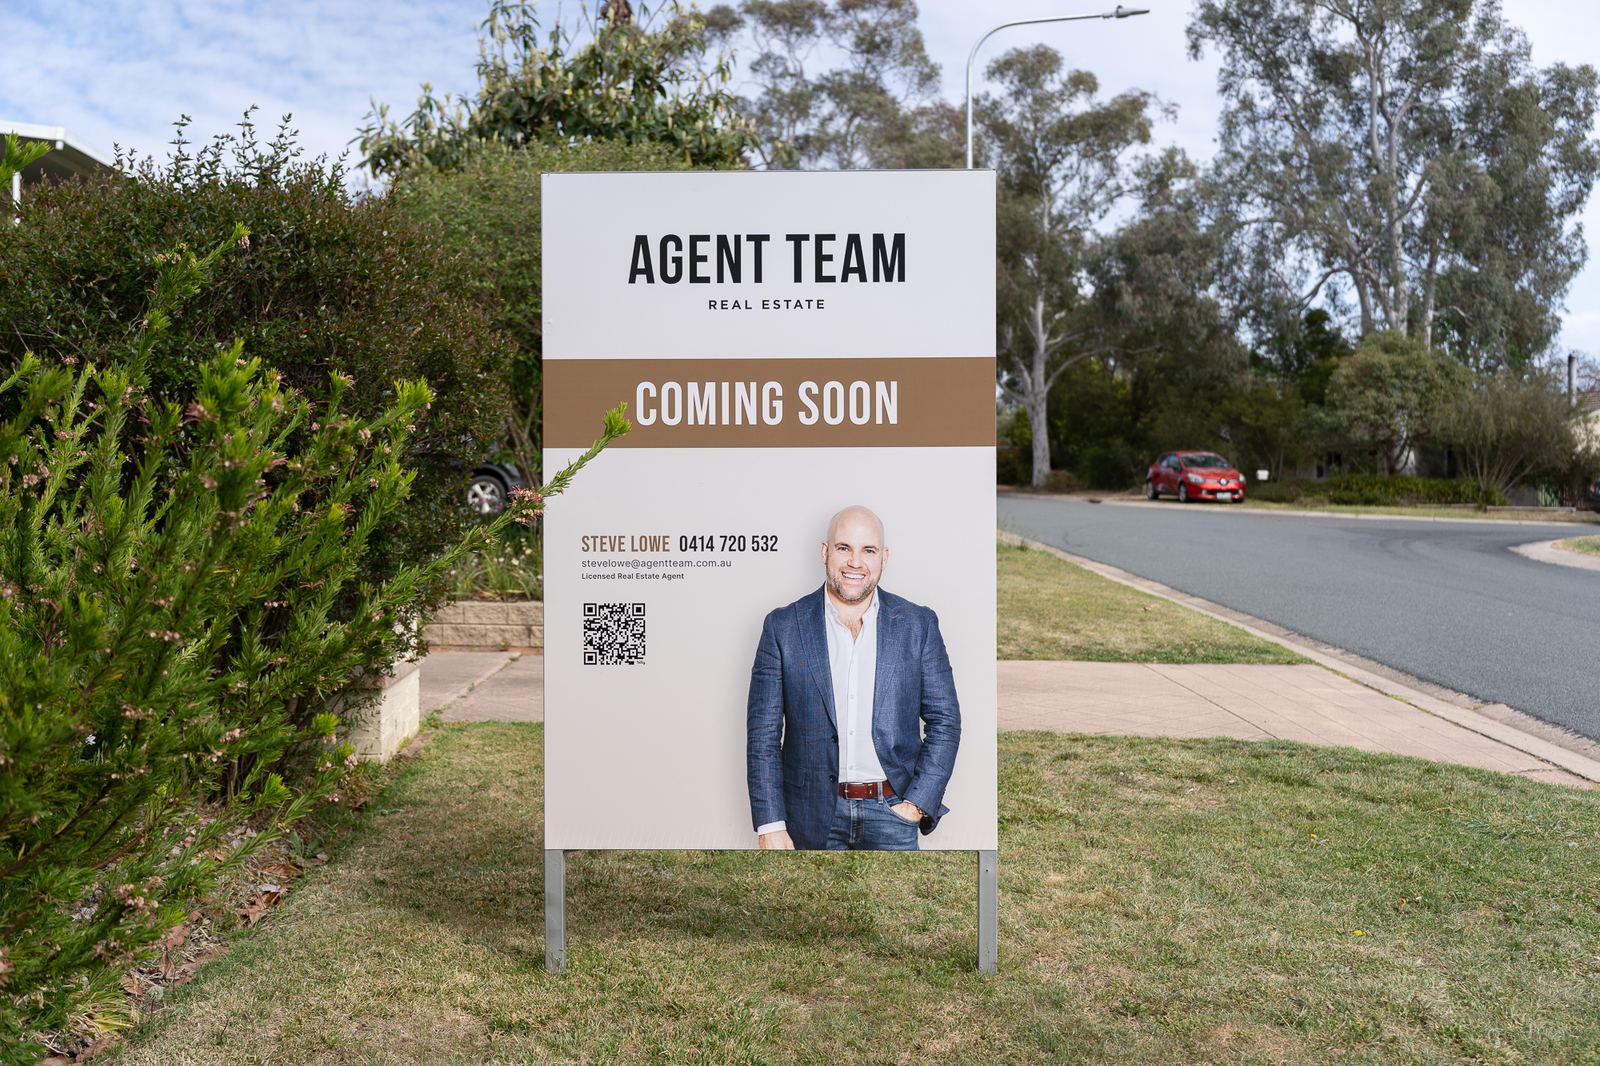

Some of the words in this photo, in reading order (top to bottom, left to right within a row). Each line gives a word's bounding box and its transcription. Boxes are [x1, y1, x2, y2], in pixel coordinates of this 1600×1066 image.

[628, 234, 770, 284] AGENT
[786, 233, 905, 283] TEAM
[708, 299, 753, 311] REAL
[761, 299, 825, 310] ESTATE
[636, 381, 783, 426] COMING
[798, 381, 898, 426] SOON
[581, 535, 626, 553] STEVE
[630, 535, 670, 553] LOWE
[679, 535, 715, 553] 0414
[720, 535, 746, 553] 720
[752, 535, 779, 553] 532
[581, 559, 732, 569] stevelowe@agentteam.com.au
[581, 572, 616, 580] Licensed
[617, 572, 634, 580] Real
[635, 572, 660, 580] Estate
[661, 572, 685, 581] Agent
